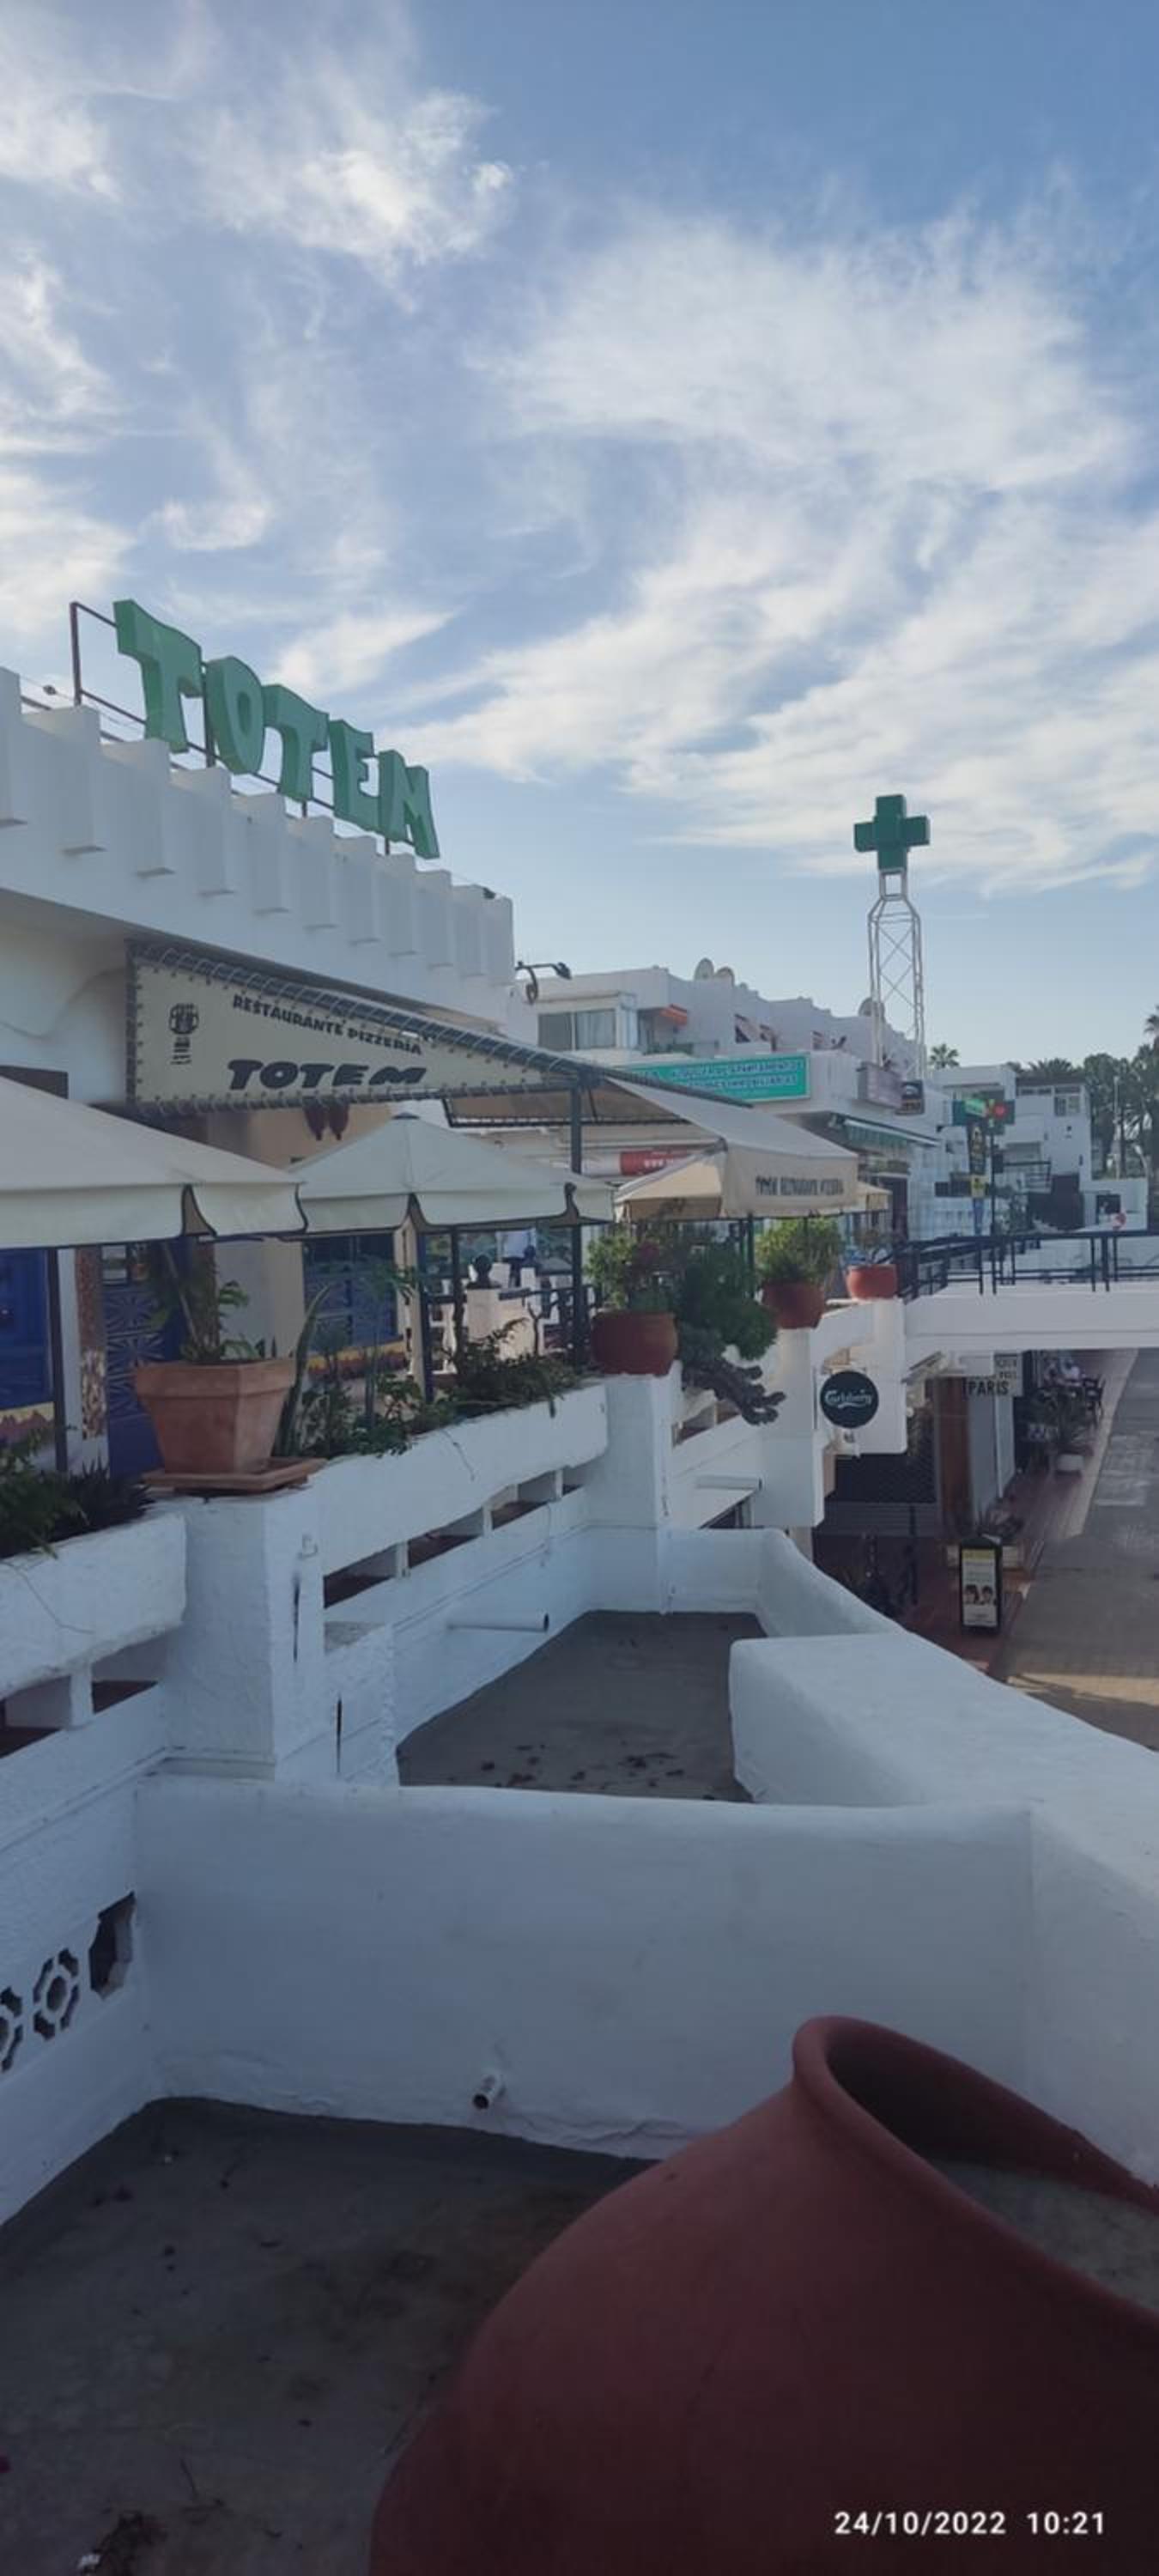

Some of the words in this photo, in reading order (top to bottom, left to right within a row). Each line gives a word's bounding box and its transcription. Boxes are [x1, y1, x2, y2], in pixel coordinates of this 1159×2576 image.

[113, 599, 440, 860] TOTEM
[233, 993, 344, 1036] RESTAURANTE
[348, 1027, 422, 1055] PIZZERIA
[228, 1059, 428, 1091] TOTEM
[968, 1380, 1010, 1395] PARIS
